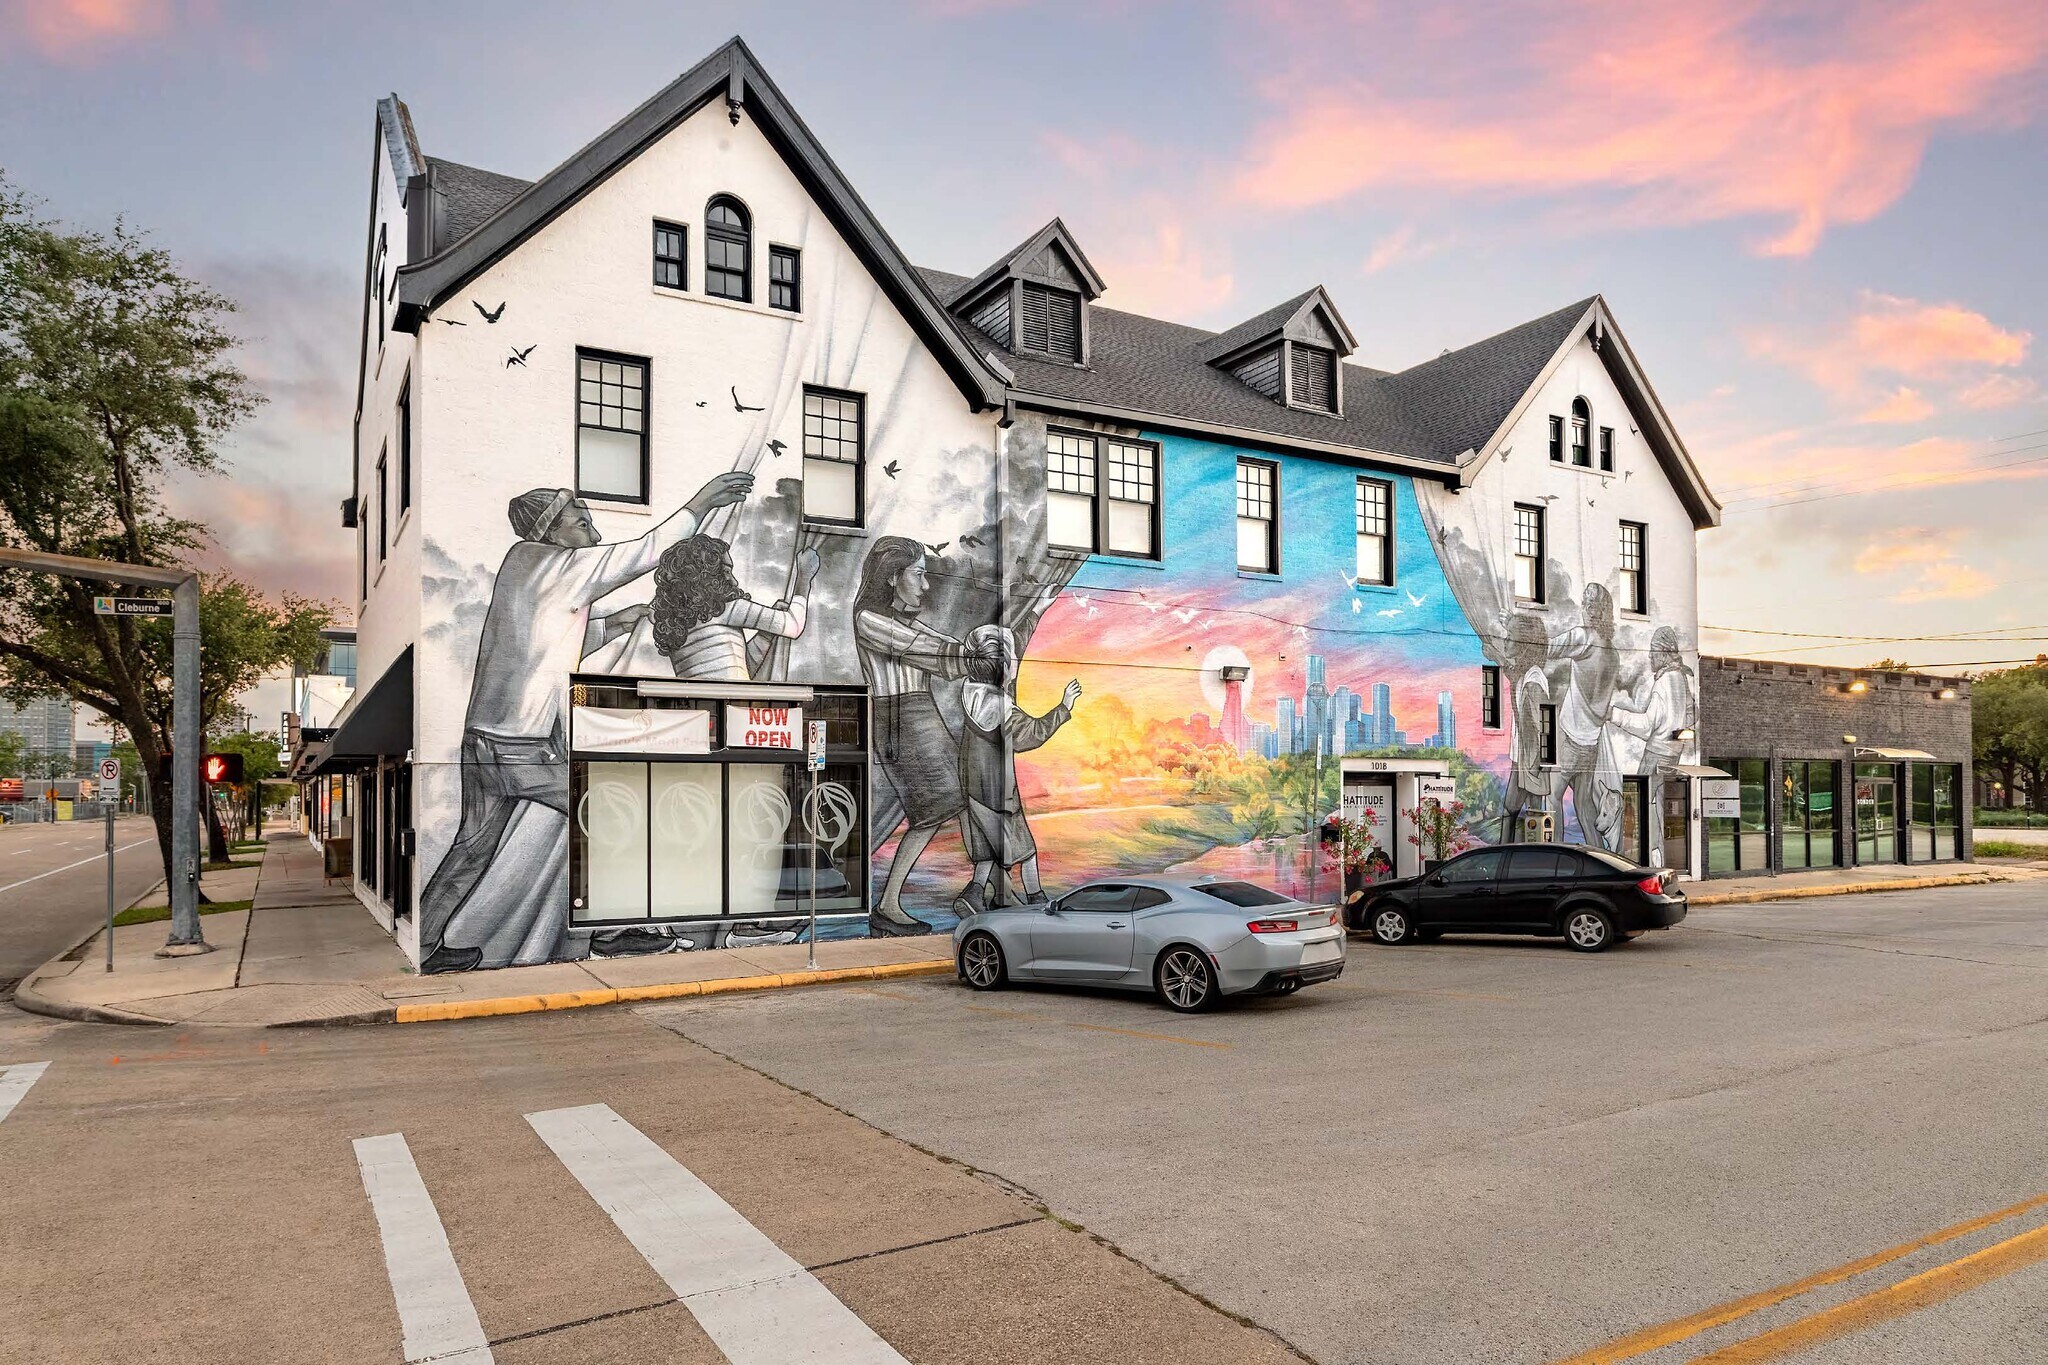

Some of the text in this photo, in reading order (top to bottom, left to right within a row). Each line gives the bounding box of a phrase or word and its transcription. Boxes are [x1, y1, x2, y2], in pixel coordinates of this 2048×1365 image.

[118, 602, 160, 612] Cleburne
[749, 708, 789, 726] NOW
[745, 730, 792, 748] OPEN
[1371, 762, 1388, 770] 1018
[1343, 795, 1384, 805] HATTITUDE
